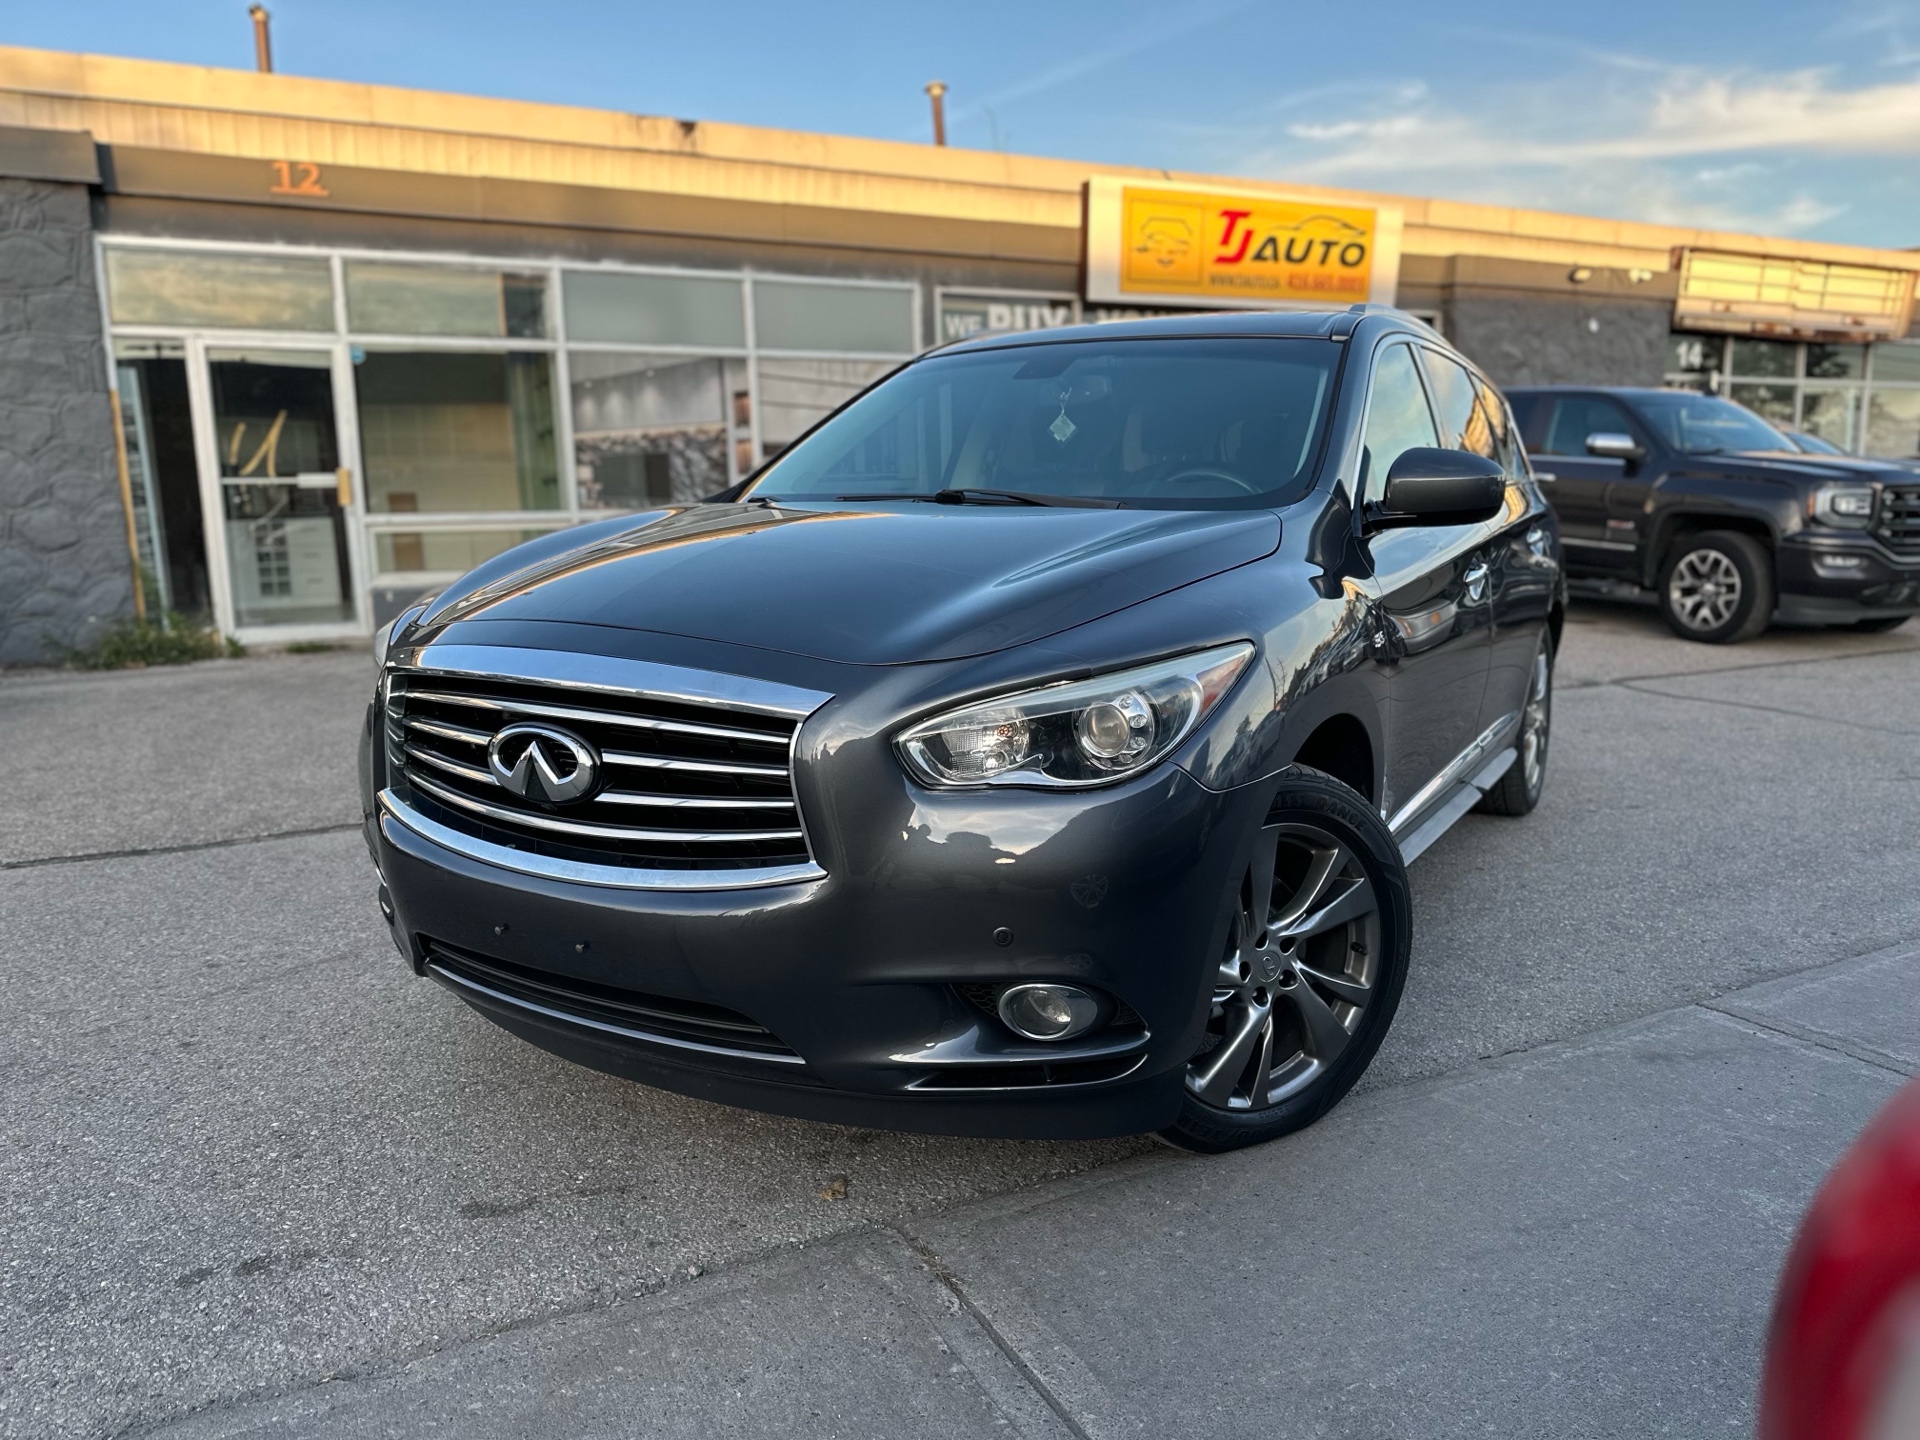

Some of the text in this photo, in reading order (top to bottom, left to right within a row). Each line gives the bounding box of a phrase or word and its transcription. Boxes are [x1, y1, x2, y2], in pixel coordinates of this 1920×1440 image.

[271, 160, 329, 197] 12
[1214, 209, 1366, 268] TJ AUTO
[944, 313, 982, 339] WE
[1676, 340, 1703, 369] 14
